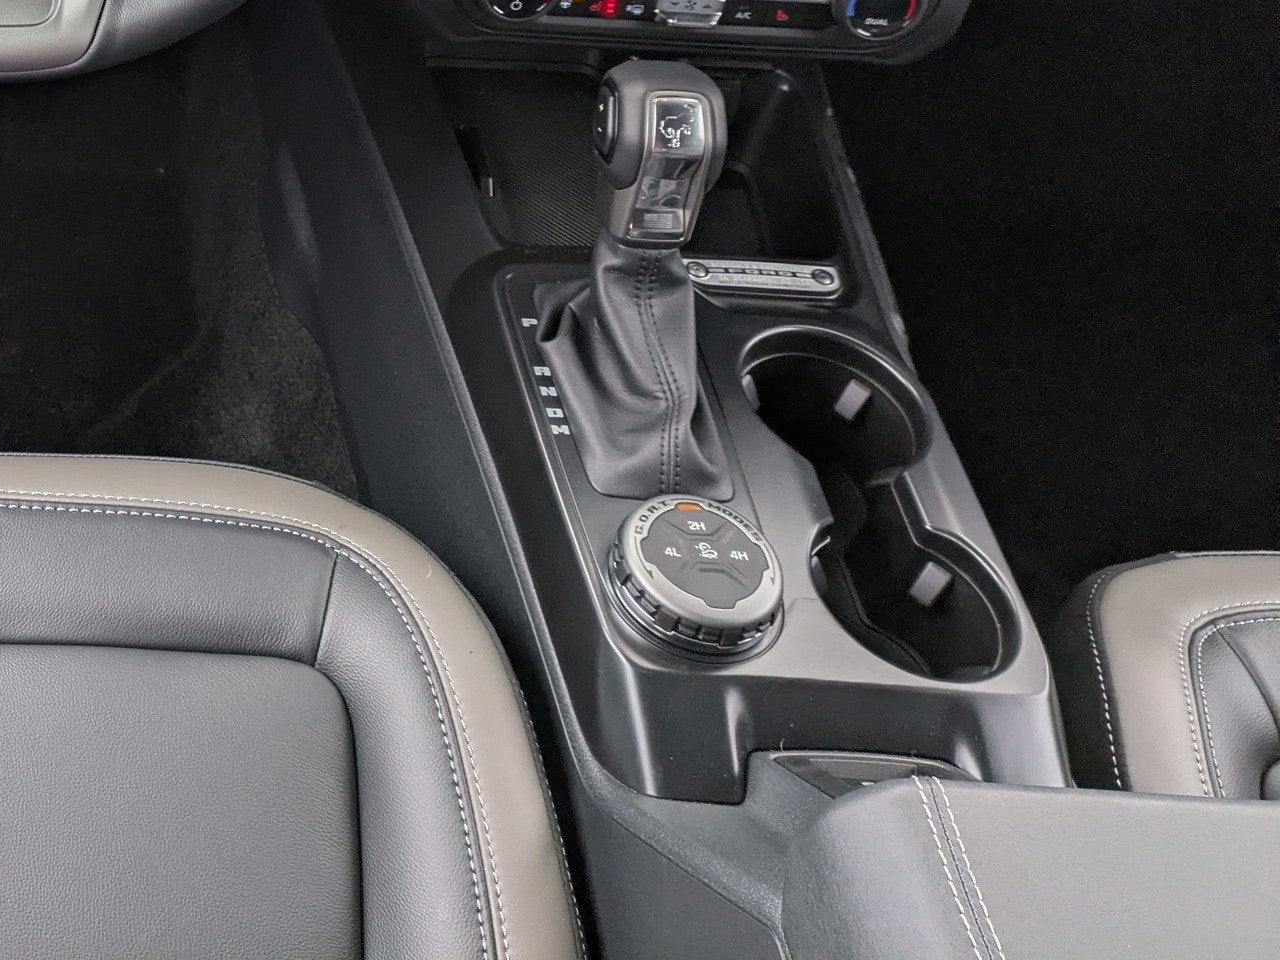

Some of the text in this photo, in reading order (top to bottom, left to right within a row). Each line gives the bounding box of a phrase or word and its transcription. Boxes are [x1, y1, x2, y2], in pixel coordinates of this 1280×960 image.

[521, 318, 538, 328] P
[539, 387, 558, 397] N
[546, 407, 564, 418] D
[550, 424, 570, 435] M
[687, 520, 706, 531] 2H
[707, 502, 763, 542] MODES
[664, 547, 682, 557] 4L
[729, 550, 749, 561] 4H
